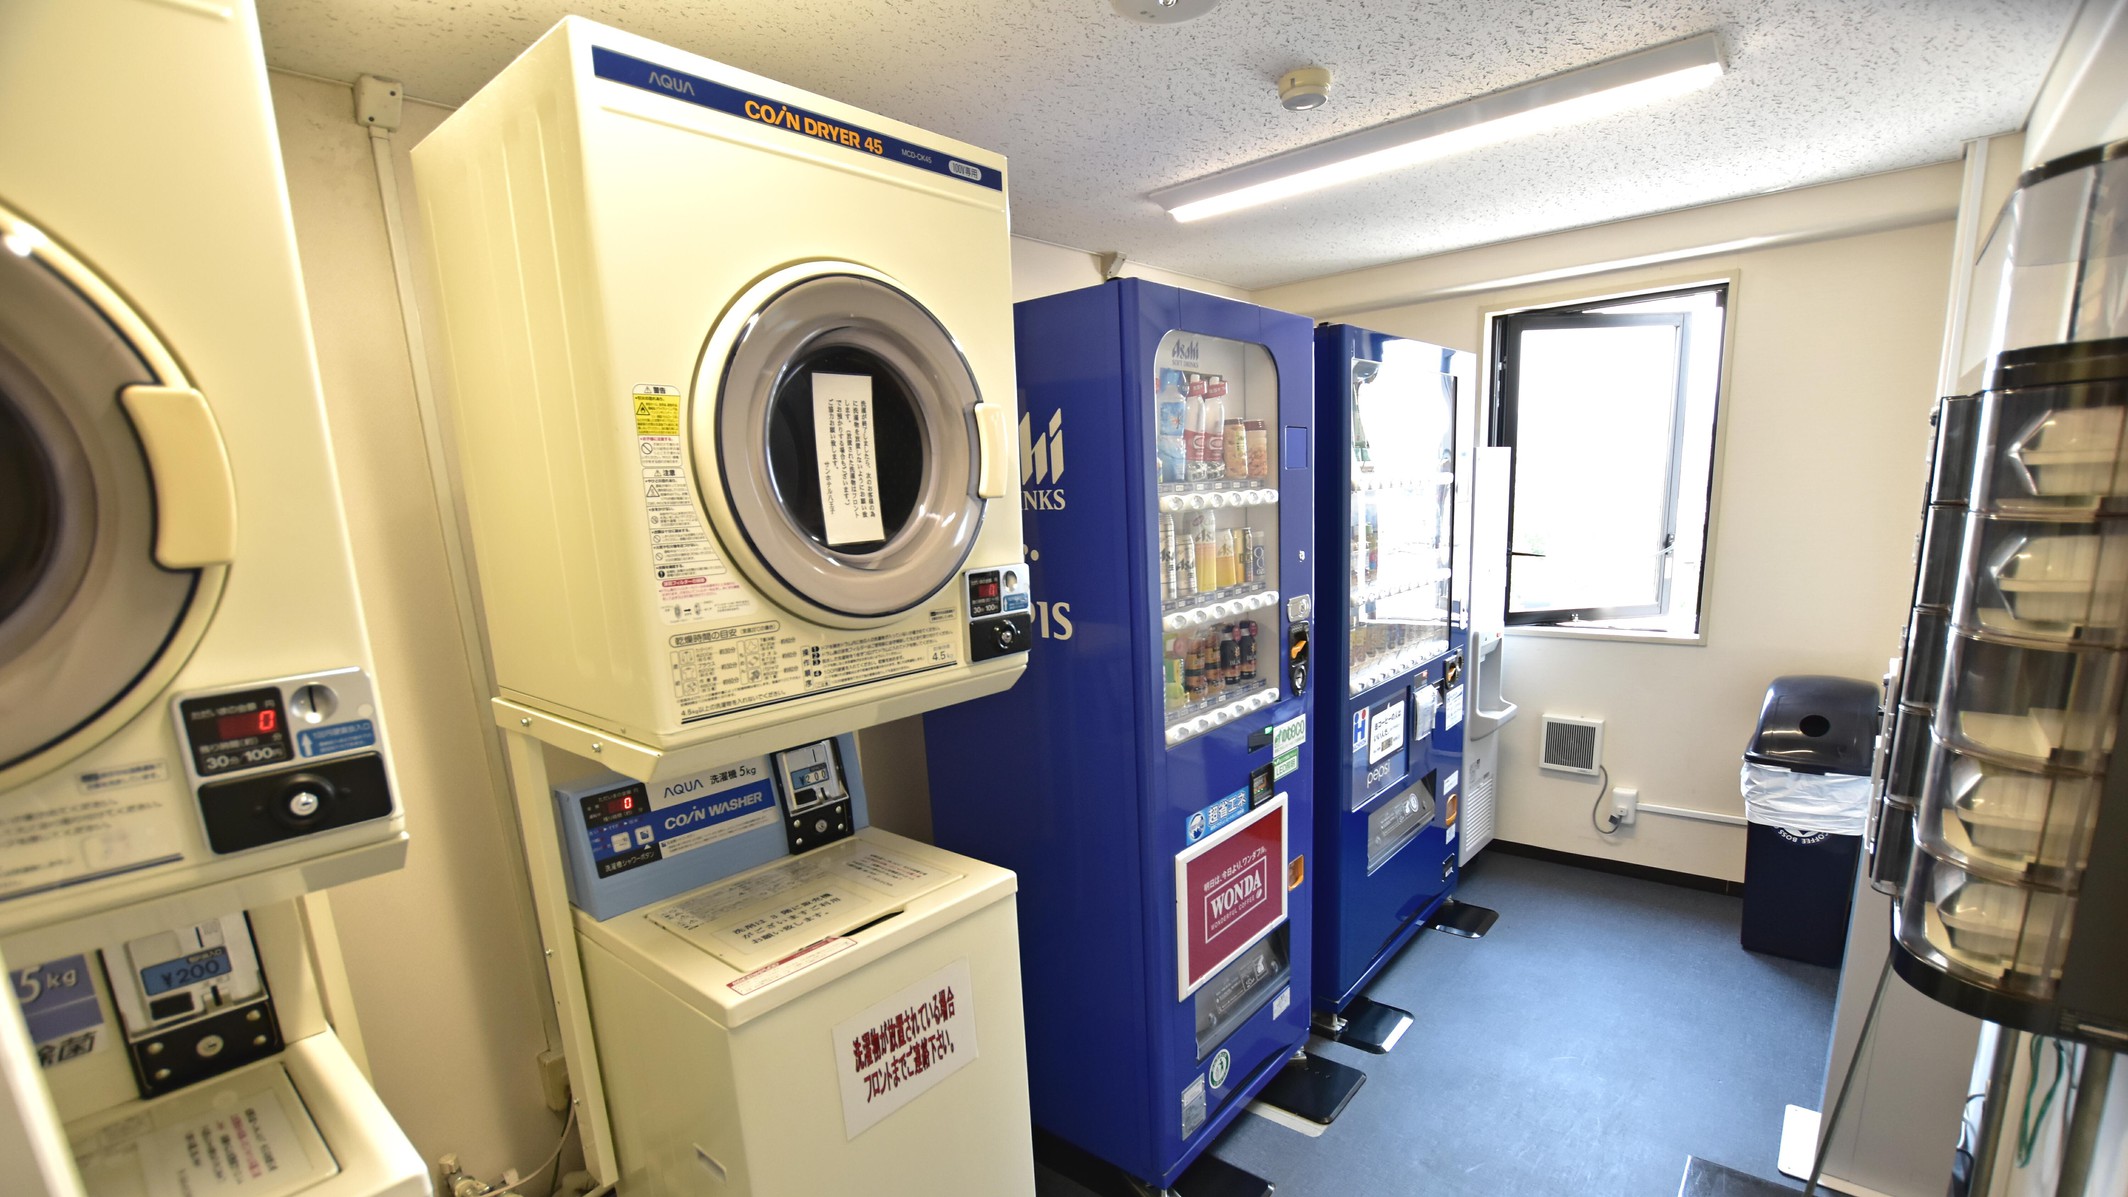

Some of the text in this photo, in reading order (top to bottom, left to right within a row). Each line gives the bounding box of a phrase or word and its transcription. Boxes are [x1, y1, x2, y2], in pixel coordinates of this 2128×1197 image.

[649, 71, 695, 96] AQUA
[804, 117, 861, 149] DRYER
[864, 137, 883, 155] 45
[1172, 339, 1199, 360] Asahi
[675, 629, 737, 646] 乾燥時間の目安
[259, 709, 277, 731] 0
[664, 779, 704, 798] AQUA
[710, 769, 737, 785] 洗濯機
[1367, 759, 1391, 789] pepsi
[624, 797, 632, 809] 0
[708, 792, 763, 816] WASHER
[1208, 791, 1247, 825] 超省エネ
[1778, 829, 1798, 843] BOSS
[1210, 869, 1262, 919] WONDA
[1211, 895, 1255, 931] WONDERFUL COFFEE
[161, 960, 220, 988] ¥200
[853, 985, 956, 1073] 洗濯物が放置されている場合
[864, 1029, 955, 1104] フロントまでご連絡下さい。
